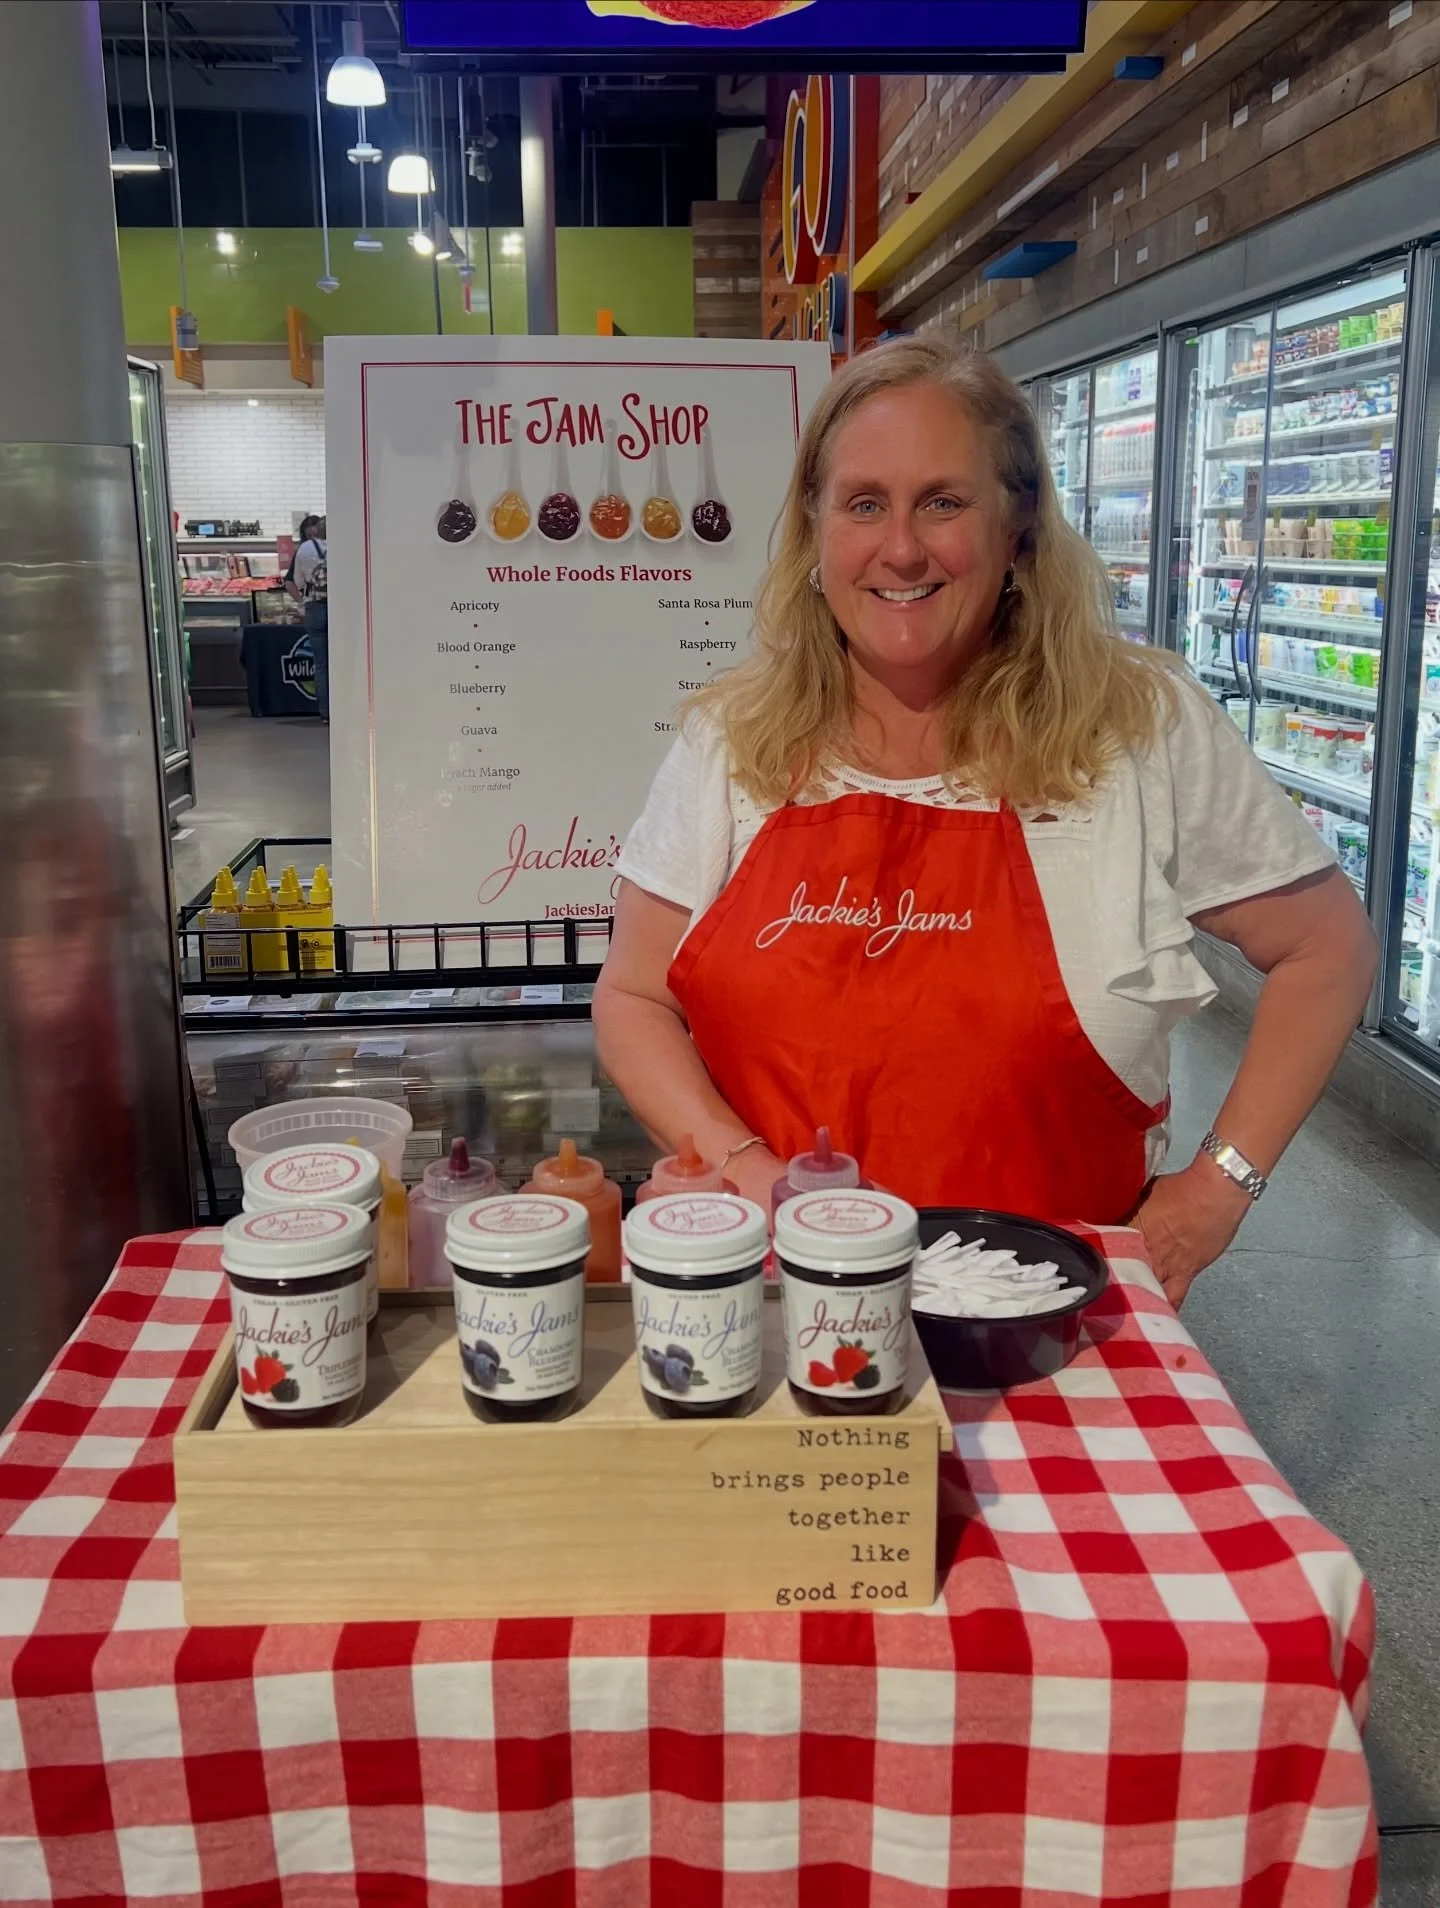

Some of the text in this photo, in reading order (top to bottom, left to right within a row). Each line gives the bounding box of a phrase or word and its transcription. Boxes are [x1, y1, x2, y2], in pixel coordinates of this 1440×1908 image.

[455, 392, 710, 460] THE JAM SHOP
[486, 565, 693, 583] Whole Foods Flavors
[450, 600, 500, 614] Apricoty
[658, 598, 753, 609] Santa Rosa Plum
[437, 640, 517, 655] Blood Orange
[679, 639, 737, 652] Raspberry
[449, 683, 507, 697] Blueberry
[461, 724, 498, 736] Guava
[479, 766, 521, 780] Mango
[487, 782, 512, 792] added
[478, 815, 621, 905] Jackie's
[755, 875, 973, 958] Jackie's Jams
[798, 1296, 891, 1349] Jackie's
[797, 1427, 910, 1449] Nothing
[711, 1468, 910, 1492] brings people
[787, 1507, 911, 1530] together
[851, 1544, 911, 1563] like
[775, 1580, 909, 1606] good food
